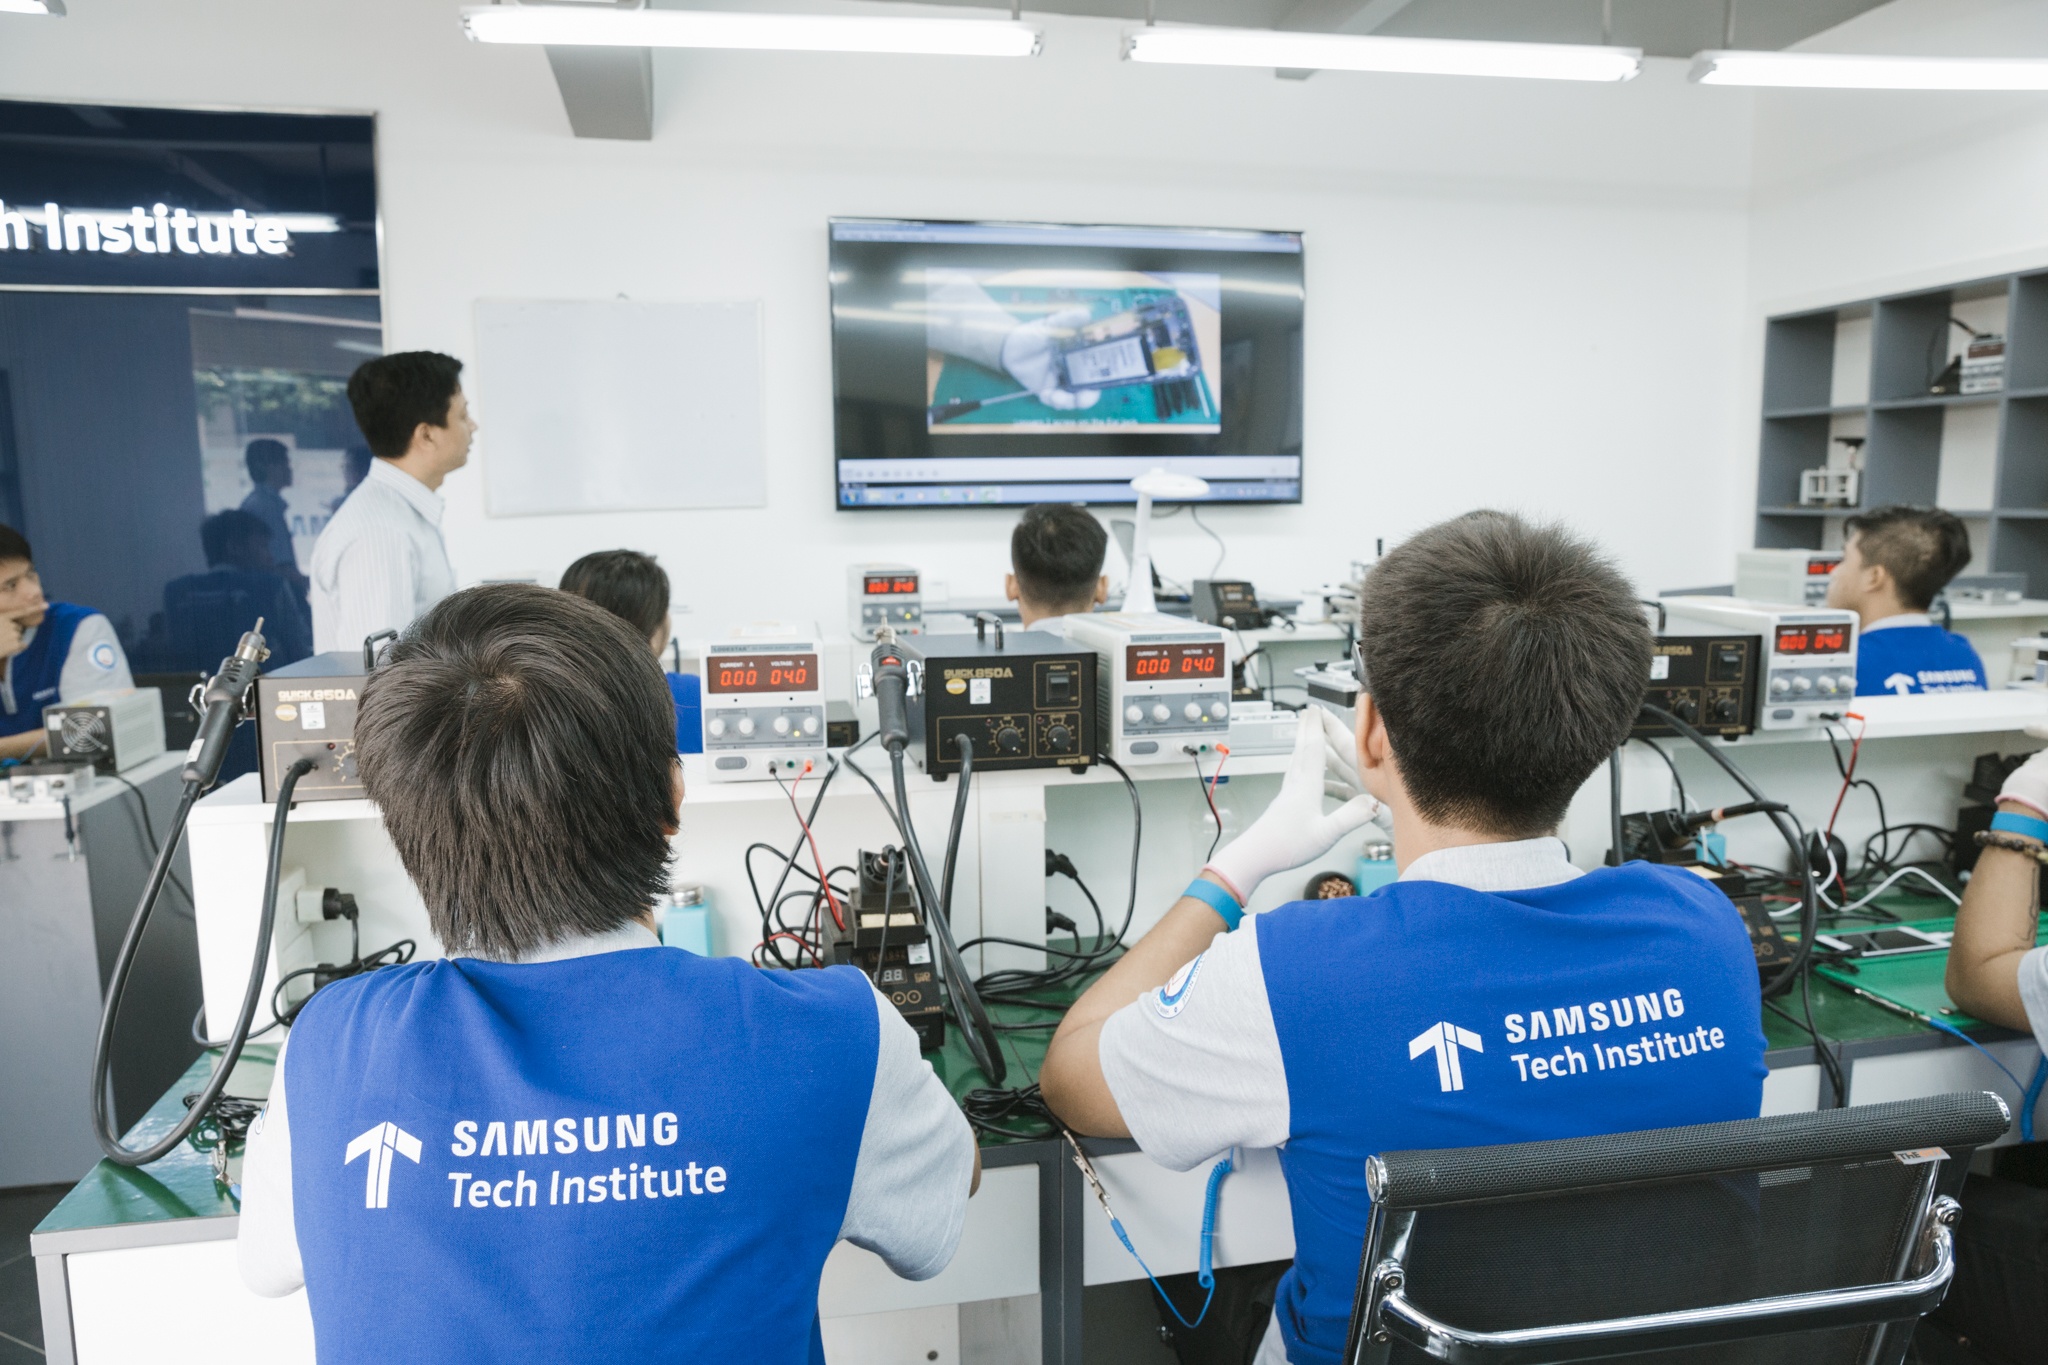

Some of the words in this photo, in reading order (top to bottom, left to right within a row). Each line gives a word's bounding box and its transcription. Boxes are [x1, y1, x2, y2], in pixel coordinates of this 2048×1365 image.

[44, 202, 288, 254] Institute
[1504, 988, 1685, 1044] SAMSUNG
[1510, 1045, 1589, 1082] Tech
[1593, 1025, 1726, 1071] Institute
[451, 1111, 679, 1157] SAMSUNG
[448, 1170, 538, 1208] Tech
[550, 1161, 728, 1206] Institute
